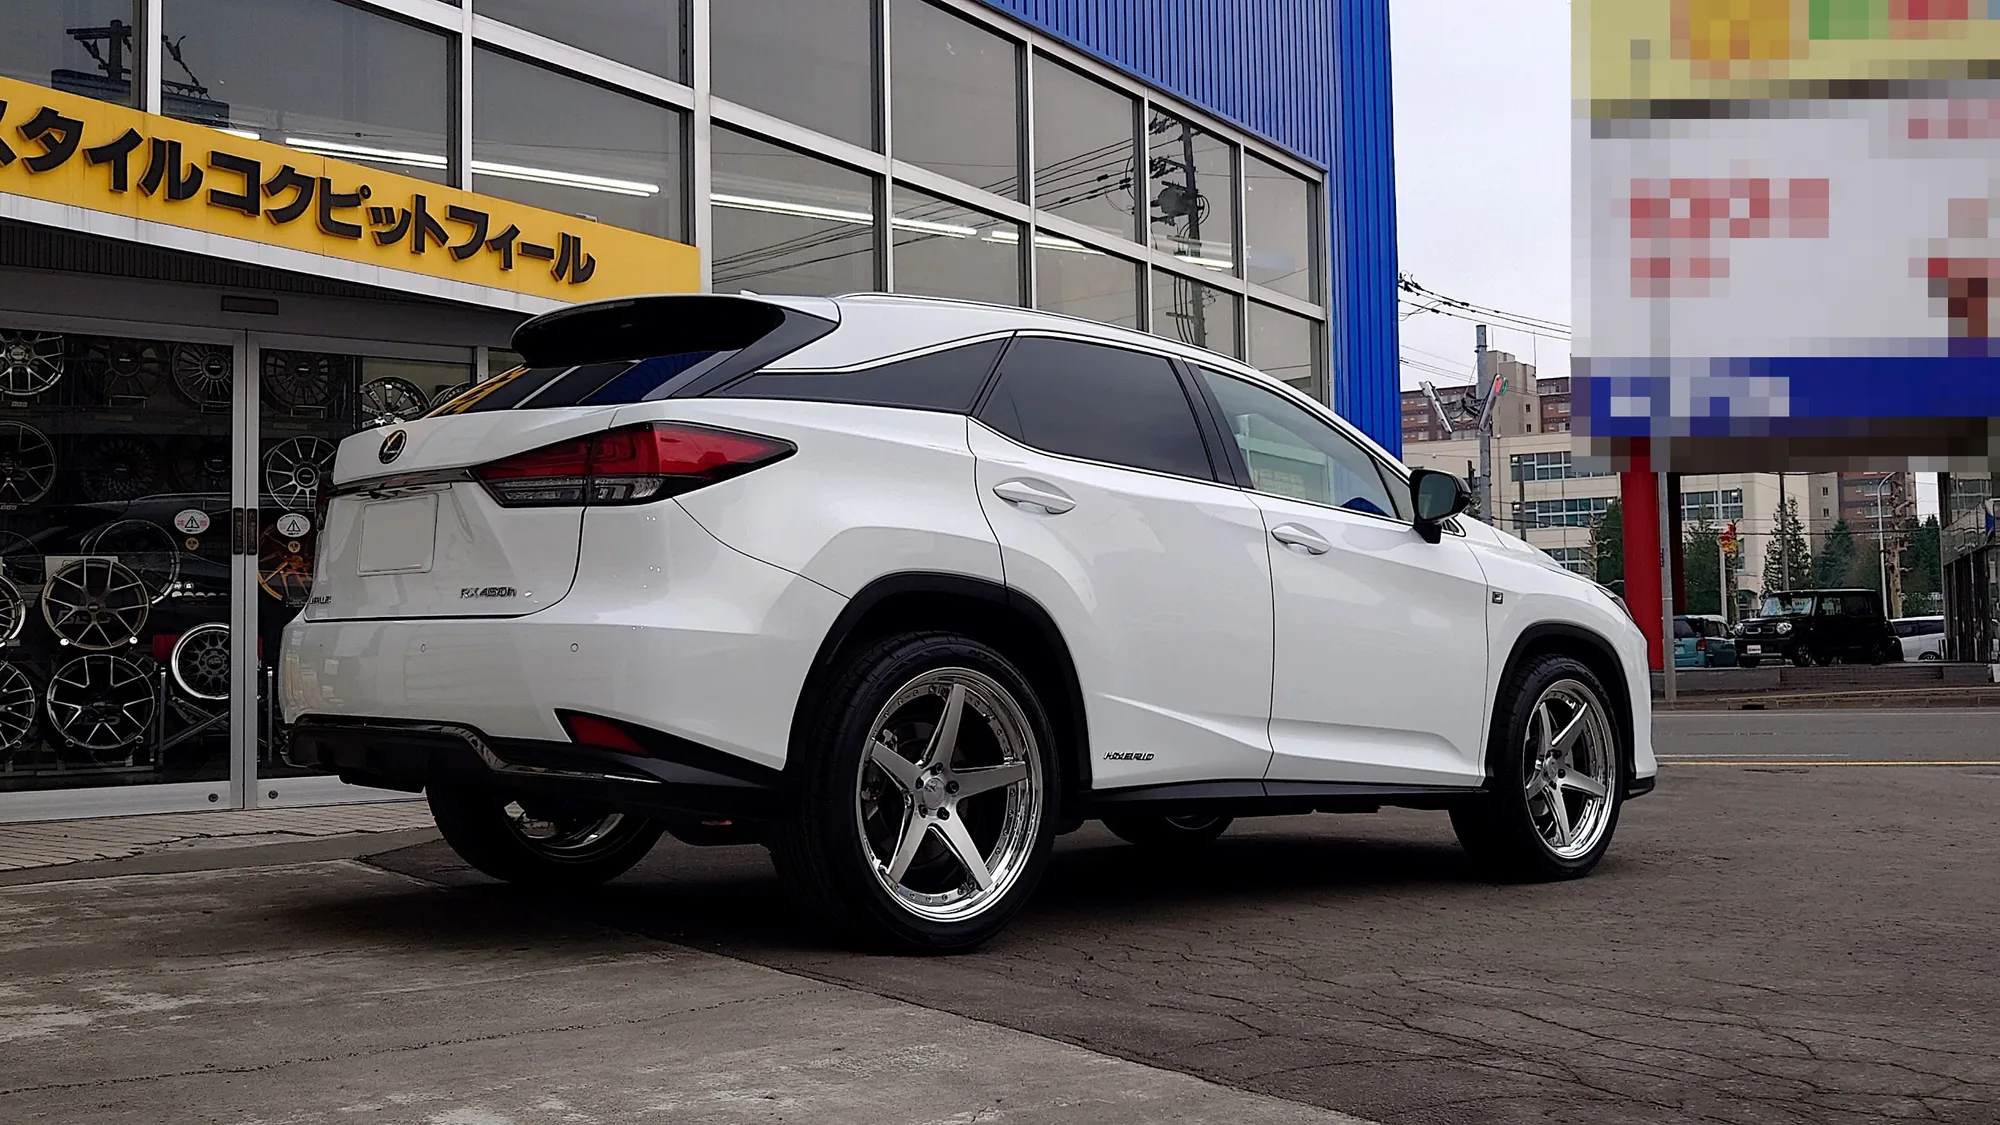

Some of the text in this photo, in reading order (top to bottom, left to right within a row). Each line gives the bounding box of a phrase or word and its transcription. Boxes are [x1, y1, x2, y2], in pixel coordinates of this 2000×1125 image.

[0, 99, 596, 284] タイルコクピットフィール
